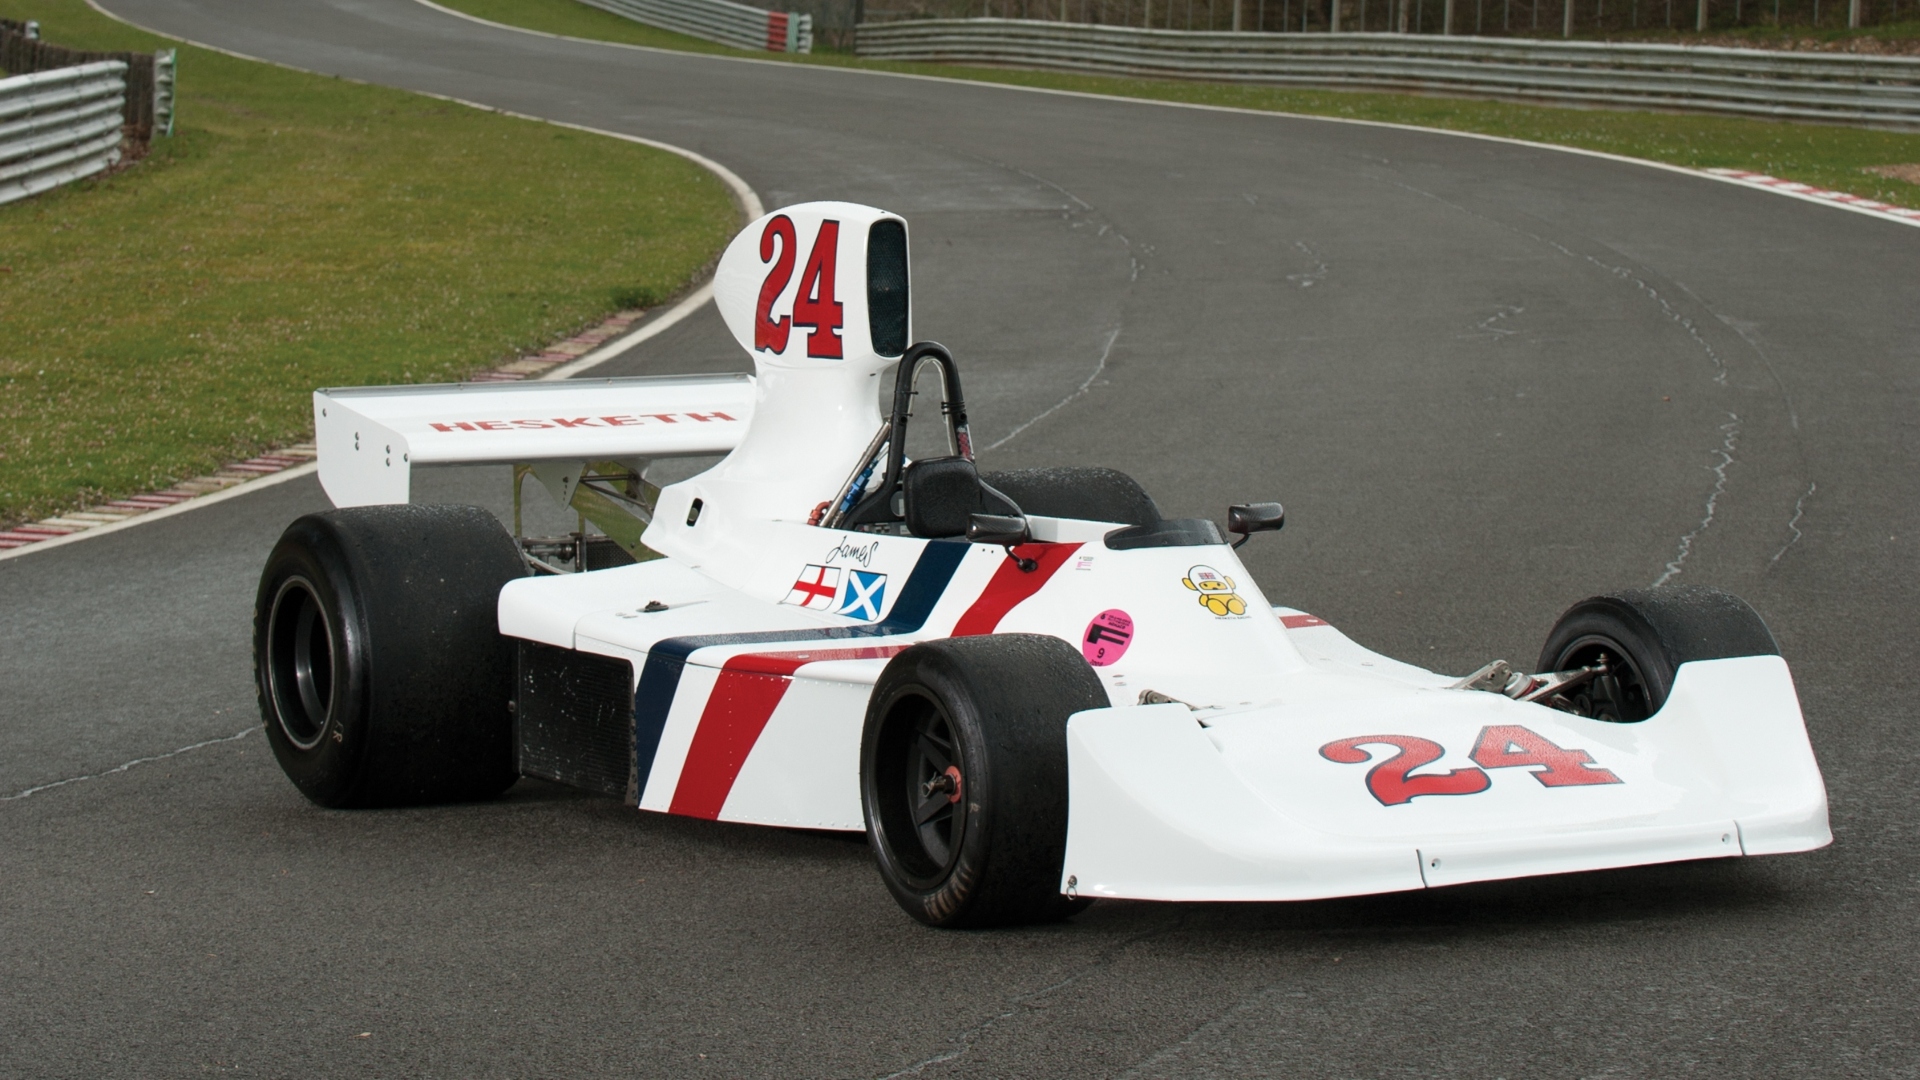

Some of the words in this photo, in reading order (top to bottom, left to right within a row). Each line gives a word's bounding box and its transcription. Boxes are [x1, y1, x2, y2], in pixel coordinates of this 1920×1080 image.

[755, 214, 843, 360] 24
[428, 411, 738, 432] HESKETH
[1097, 647, 1105, 659] 9
[1318, 724, 1625, 807] 24
